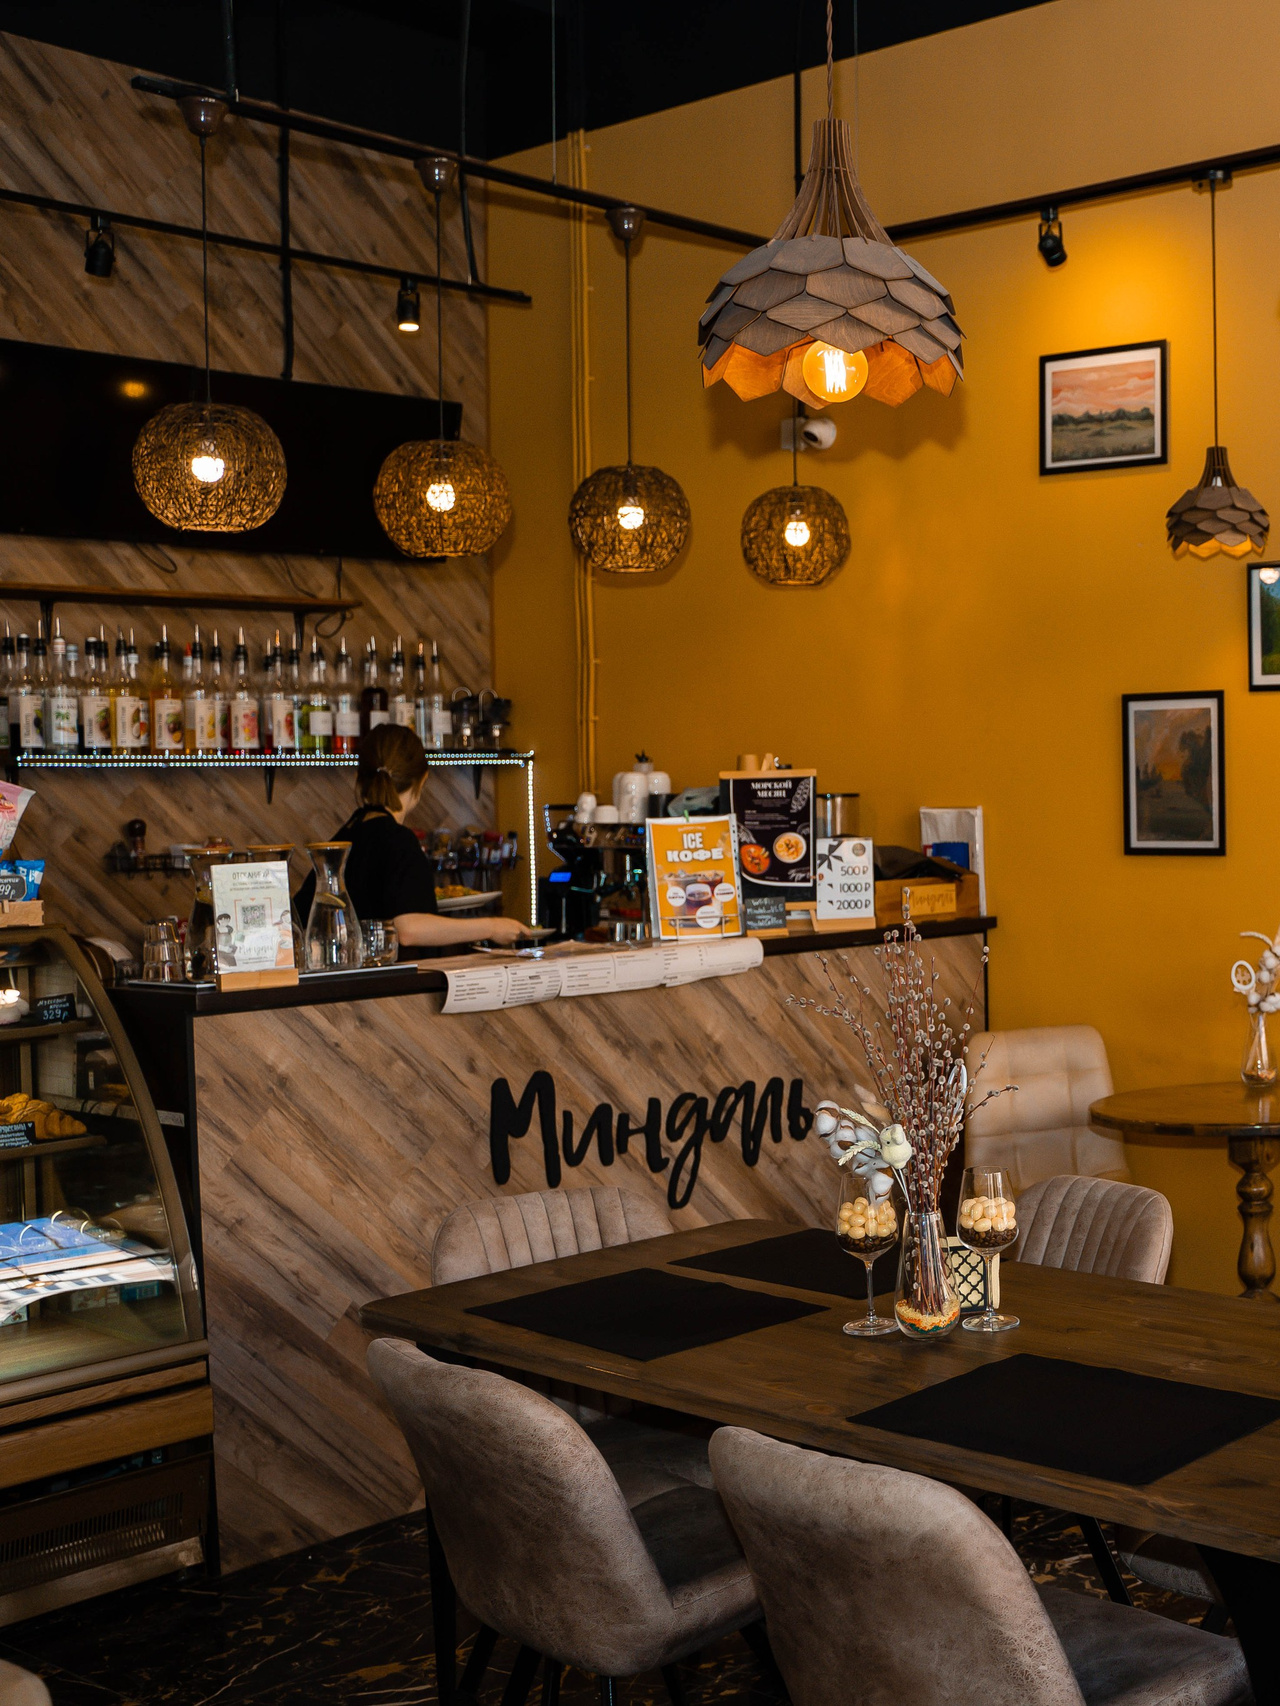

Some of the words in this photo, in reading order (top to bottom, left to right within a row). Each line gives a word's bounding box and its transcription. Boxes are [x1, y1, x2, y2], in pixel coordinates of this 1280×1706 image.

[751, 779, 793, 790] МОРСКОЙ
[757, 789, 787, 798] МЕСЯЦ
[682, 832, 704, 849] ICE
[666, 847, 724, 863] КОФЕ
[840, 865, 861, 877] 500
[839, 882, 863, 893] 1000
[836, 899, 863, 910] 2000
[489, 1070, 815, 1209] Миндаль
